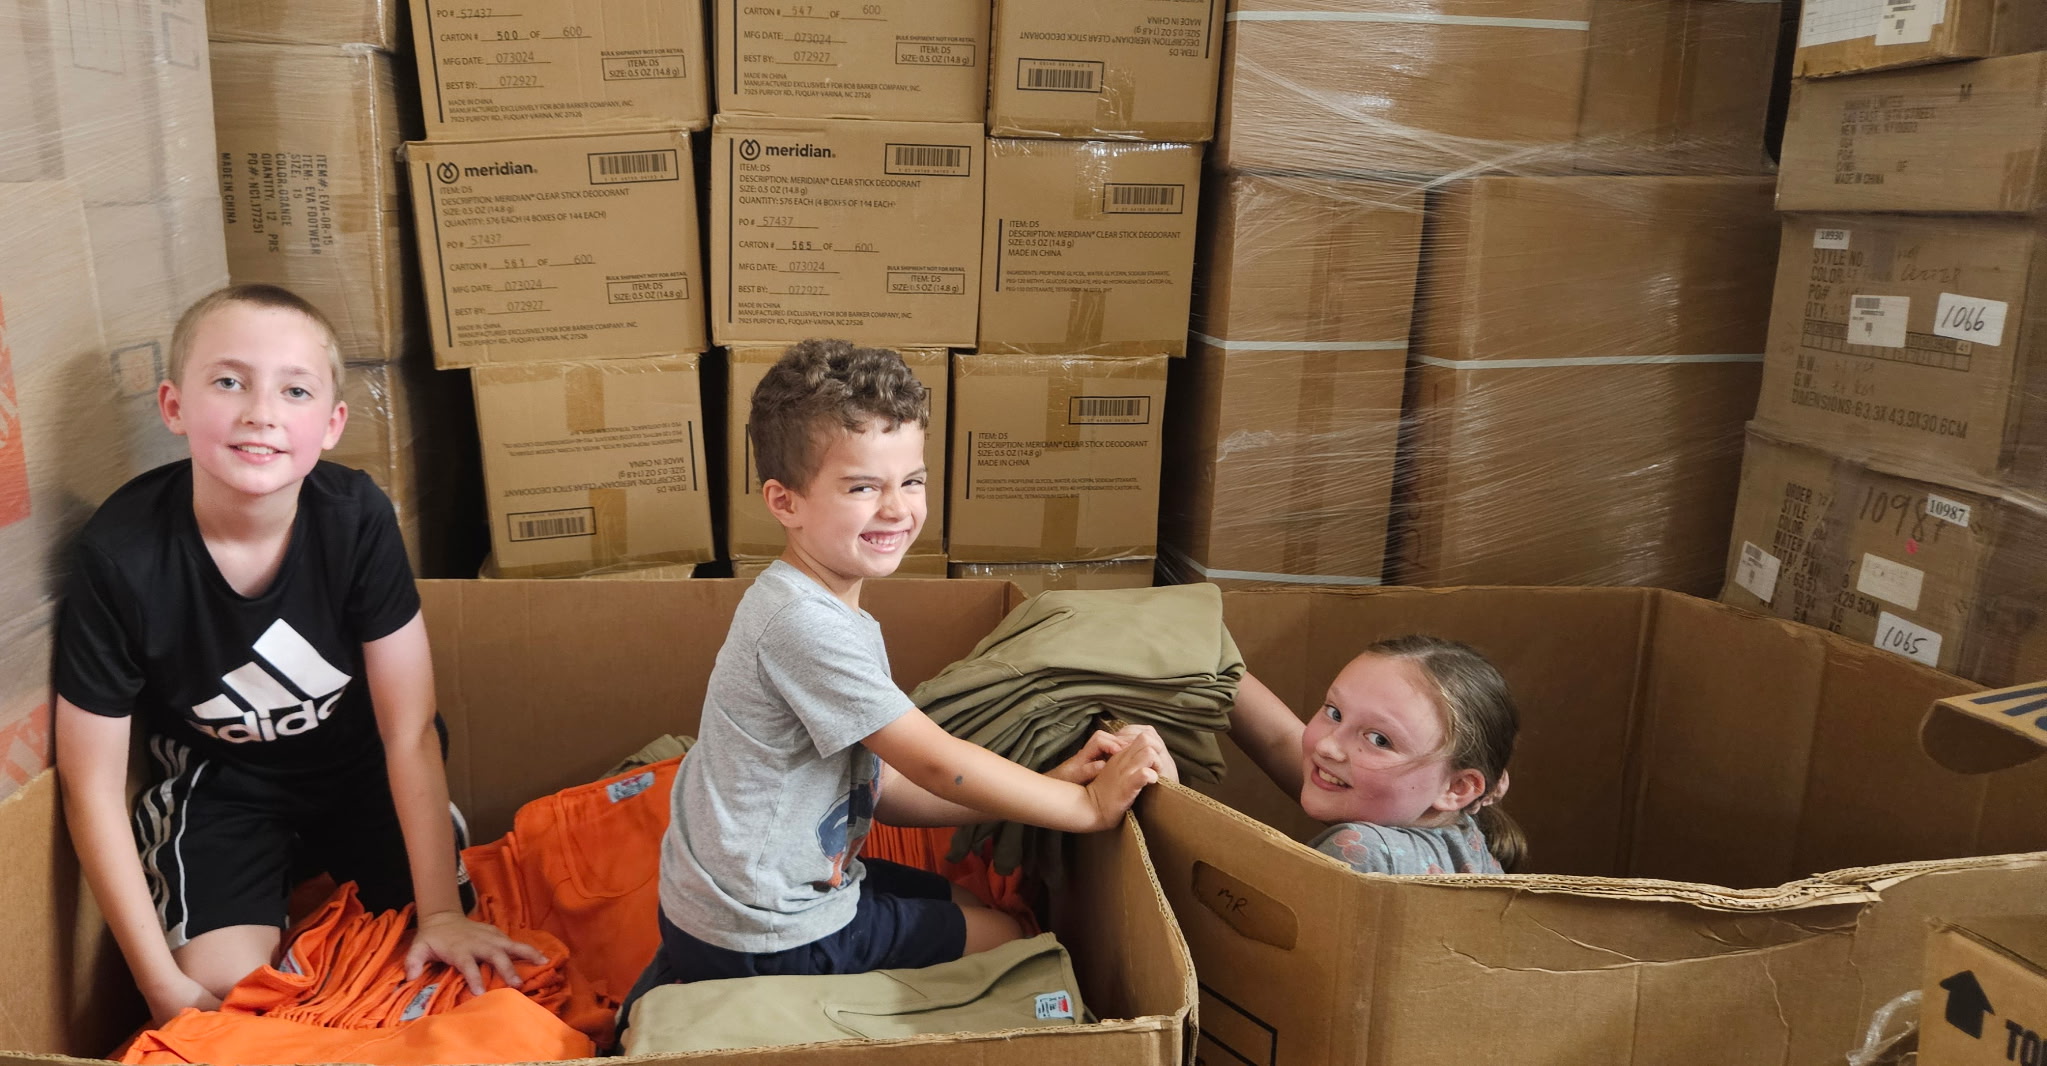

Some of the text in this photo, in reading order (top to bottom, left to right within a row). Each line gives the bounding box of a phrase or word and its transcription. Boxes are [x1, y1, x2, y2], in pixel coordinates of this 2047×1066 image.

[437, 8, 492, 19] PO # 57437
[744, 7, 775, 16] CARTON
[792, 6, 814, 16] 547
[830, 10, 840, 19] OF
[862, 4, 880, 16] 600
[1146, 16, 1202, 26] MADE IN CHINA
[440, 33, 472, 42] CARTON
[497, 30, 519, 41] 500
[530, 30, 540, 39] OF
[562, 26, 582, 37] 600
[744, 31, 831, 45] MFG DATE: 073024
[443, 52, 534, 66] MFG DATE: 073024
[744, 52, 830, 64] BEST BY: 072927
[446, 76, 538, 90] BEST BY: 072927
[766, 144, 832, 158] meridian
[464, 162, 534, 178] meridian
[740, 164, 759, 172] ITEM:
[290, 154, 302, 199] SIZE: 15
[739, 174, 788, 184] DESCRIPTION:
[830, 178, 853, 186] CLEAR
[854, 178, 874, 187] STICK
[875, 179, 921, 188] DEODORANT
[221, 152, 237, 224] MADE IN CHINA
[261, 153, 280, 253] QUANTITY: 12 PRS
[302, 154, 322, 256] ITEM: EVA FOOTWEAR
[739, 218, 750, 226] PO
[763, 216, 794, 226] 57437
[1010, 220, 1028, 228] ITEM:
[1008, 230, 1056, 238] DESCRIPTION:
[1096, 231, 1118, 239] CLEAR
[1119, 231, 1138, 239] STICK
[1138, 231, 1181, 239] DEODORANT
[446, 241, 458, 250] PO
[470, 234, 502, 246] 57437
[739, 240, 769, 249] CARTON
[792, 240, 812, 250] 565
[823, 242, 832, 251] OF
[855, 242, 874, 252] 600
[1008, 249, 1062, 257] MADE IN CHINA
[1813, 249, 1845, 266] STYLE
[450, 262, 482, 272] CARTON
[504, 258, 525, 269] 561
[538, 259, 548, 267] OF
[574, 254, 593, 264] 600
[739, 262, 825, 272] MFG DATE: 073024
[1941, 305, 1986, 332] 1066
[978, 432, 997, 440] ITEM:
[978, 441, 1024, 449] DESCRIPTION:
[1063, 440, 1084, 448] CLEAR
[1085, 440, 1104, 448] STICK
[1104, 440, 1148, 448] DEODORANT
[628, 457, 685, 468] MADE IN CHINA
[1929, 499, 1966, 523] 10987
[1882, 626, 1928, 655] 1065
[185, 687, 346, 744] dida
[2006, 1018, 2047, 1066] TO
